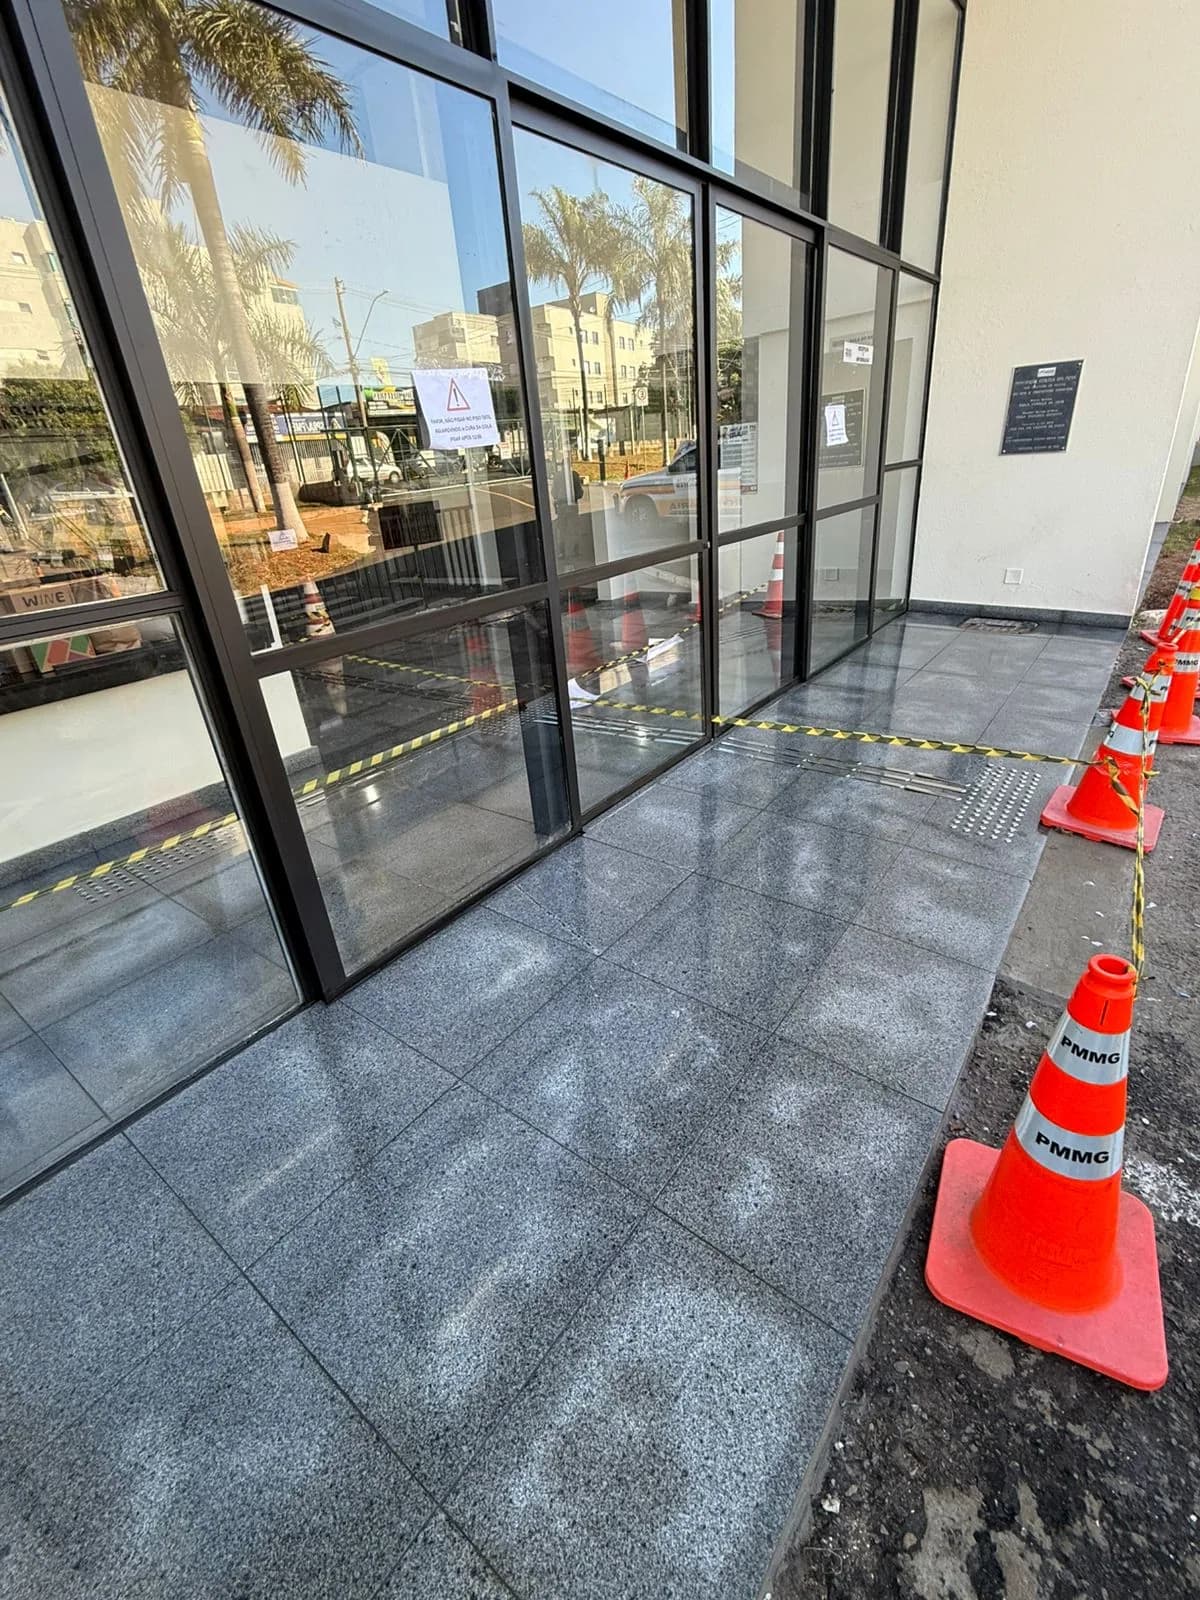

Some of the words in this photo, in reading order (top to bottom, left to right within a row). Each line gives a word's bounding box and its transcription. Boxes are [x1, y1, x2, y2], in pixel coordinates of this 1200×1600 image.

[22, 591, 66, 607] WINE
[1060, 1034, 1121, 1065] PMMG
[1034, 1131, 1110, 1165] PMMG
